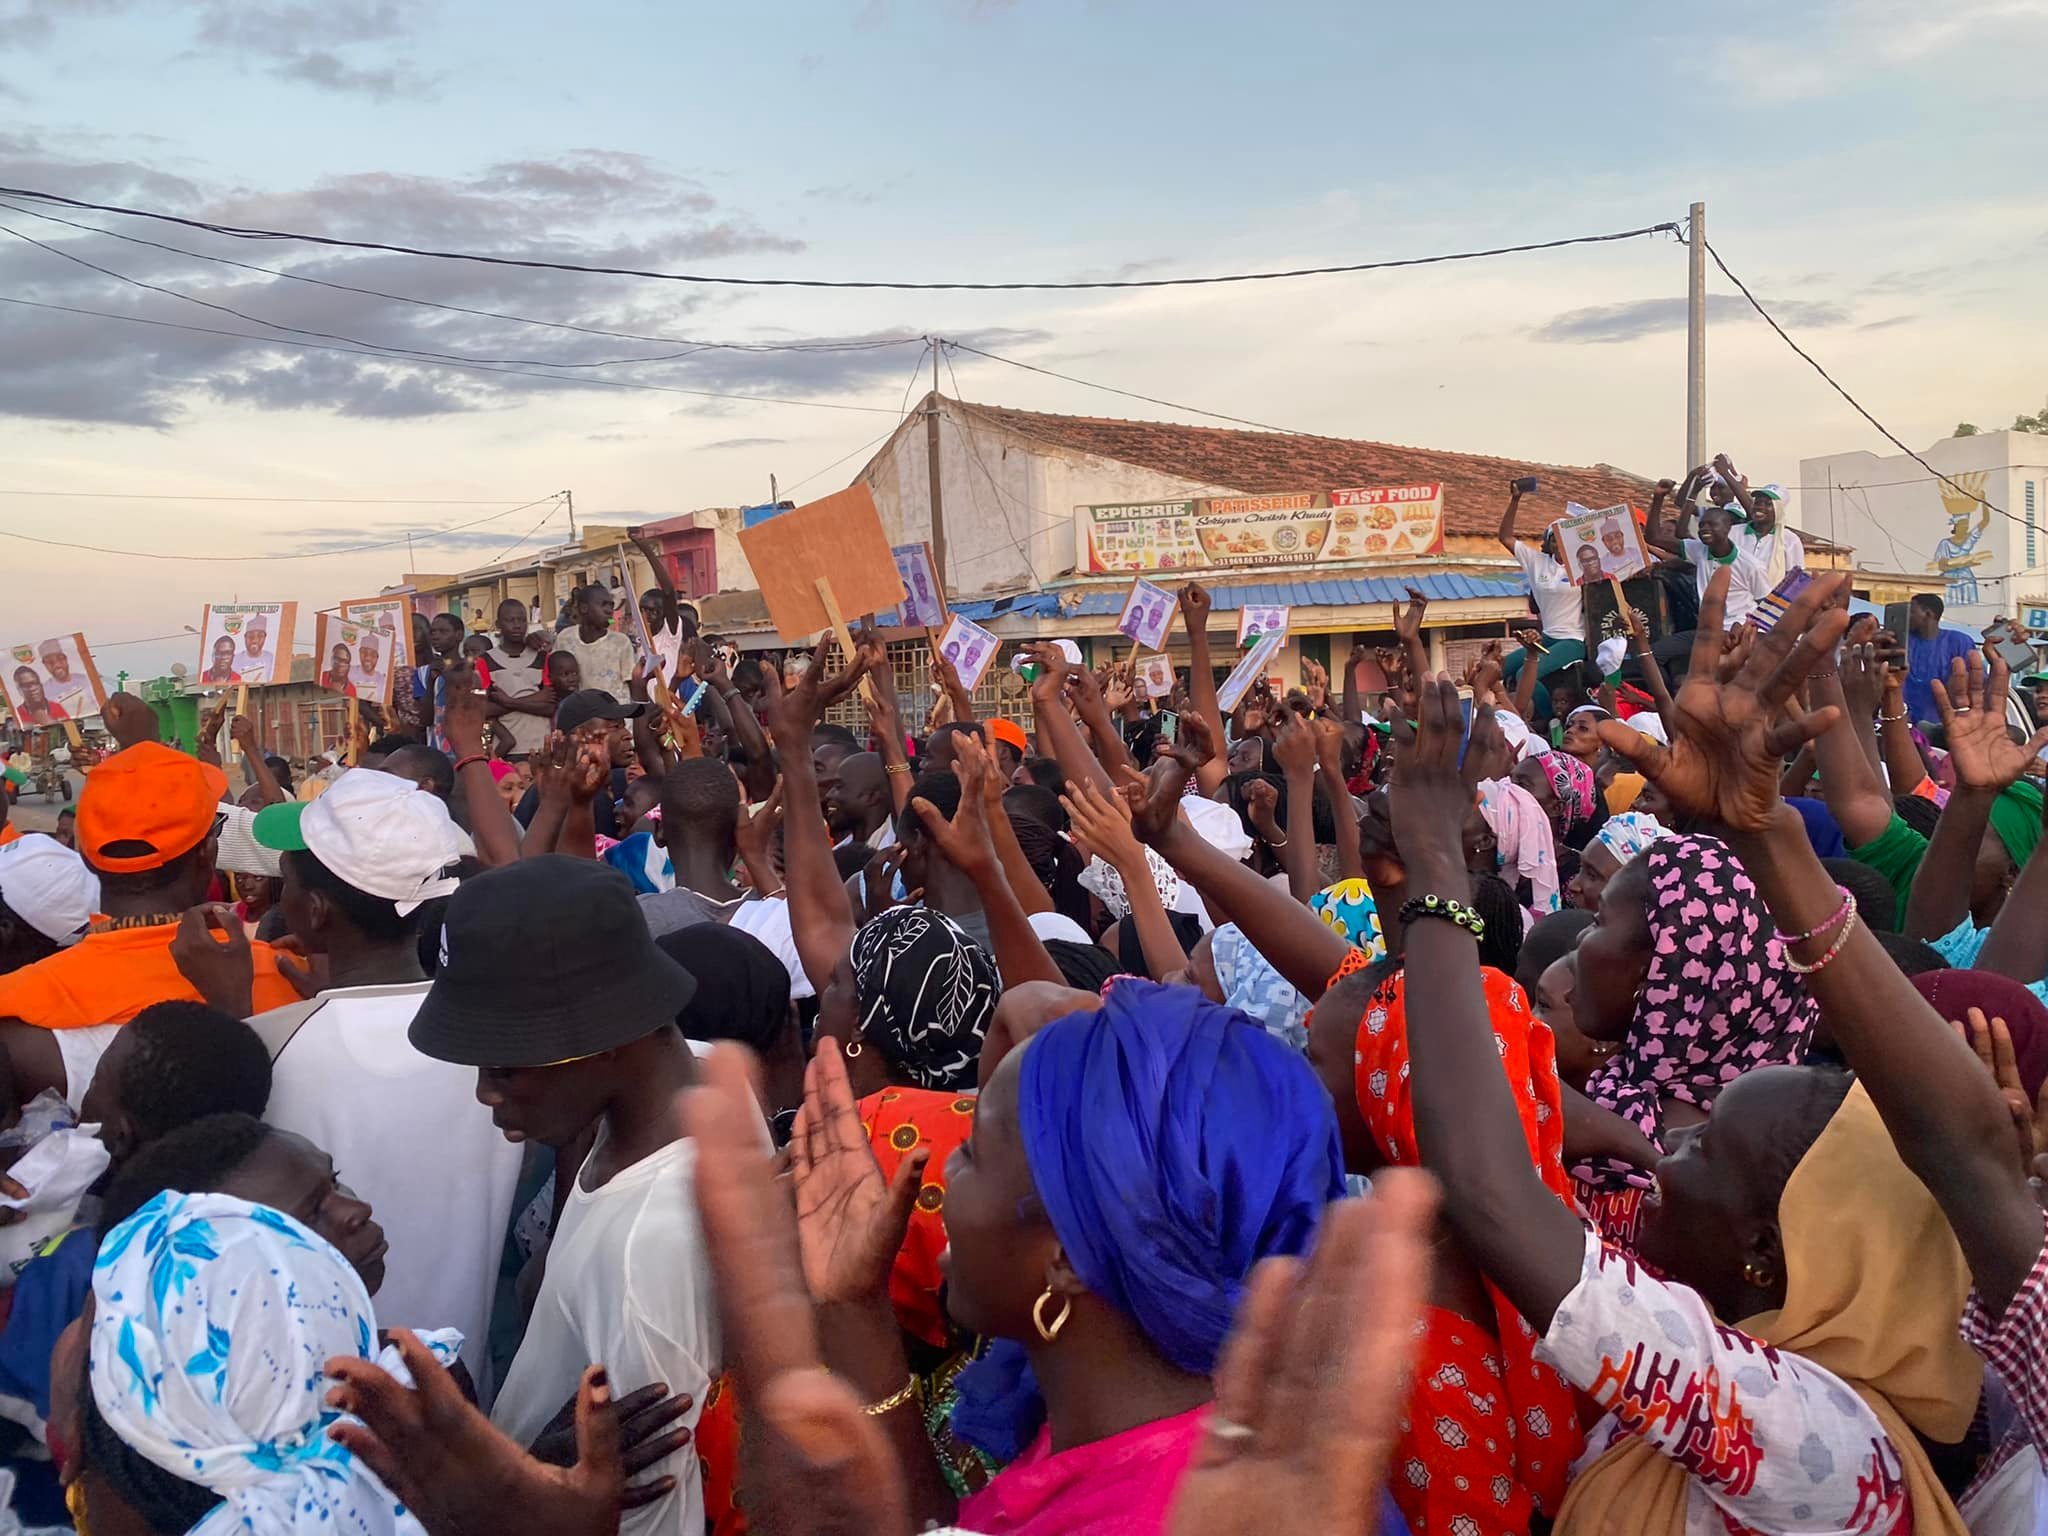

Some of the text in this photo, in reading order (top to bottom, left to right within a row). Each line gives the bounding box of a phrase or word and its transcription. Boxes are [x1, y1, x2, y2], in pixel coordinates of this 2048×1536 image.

[1339, 486, 1431, 504] FAST FOOD
[1095, 504, 1185, 520] EPICERIE
[1211, 495, 1311, 513] PATISSERIE
[1290, 510, 1332, 521] Khady
